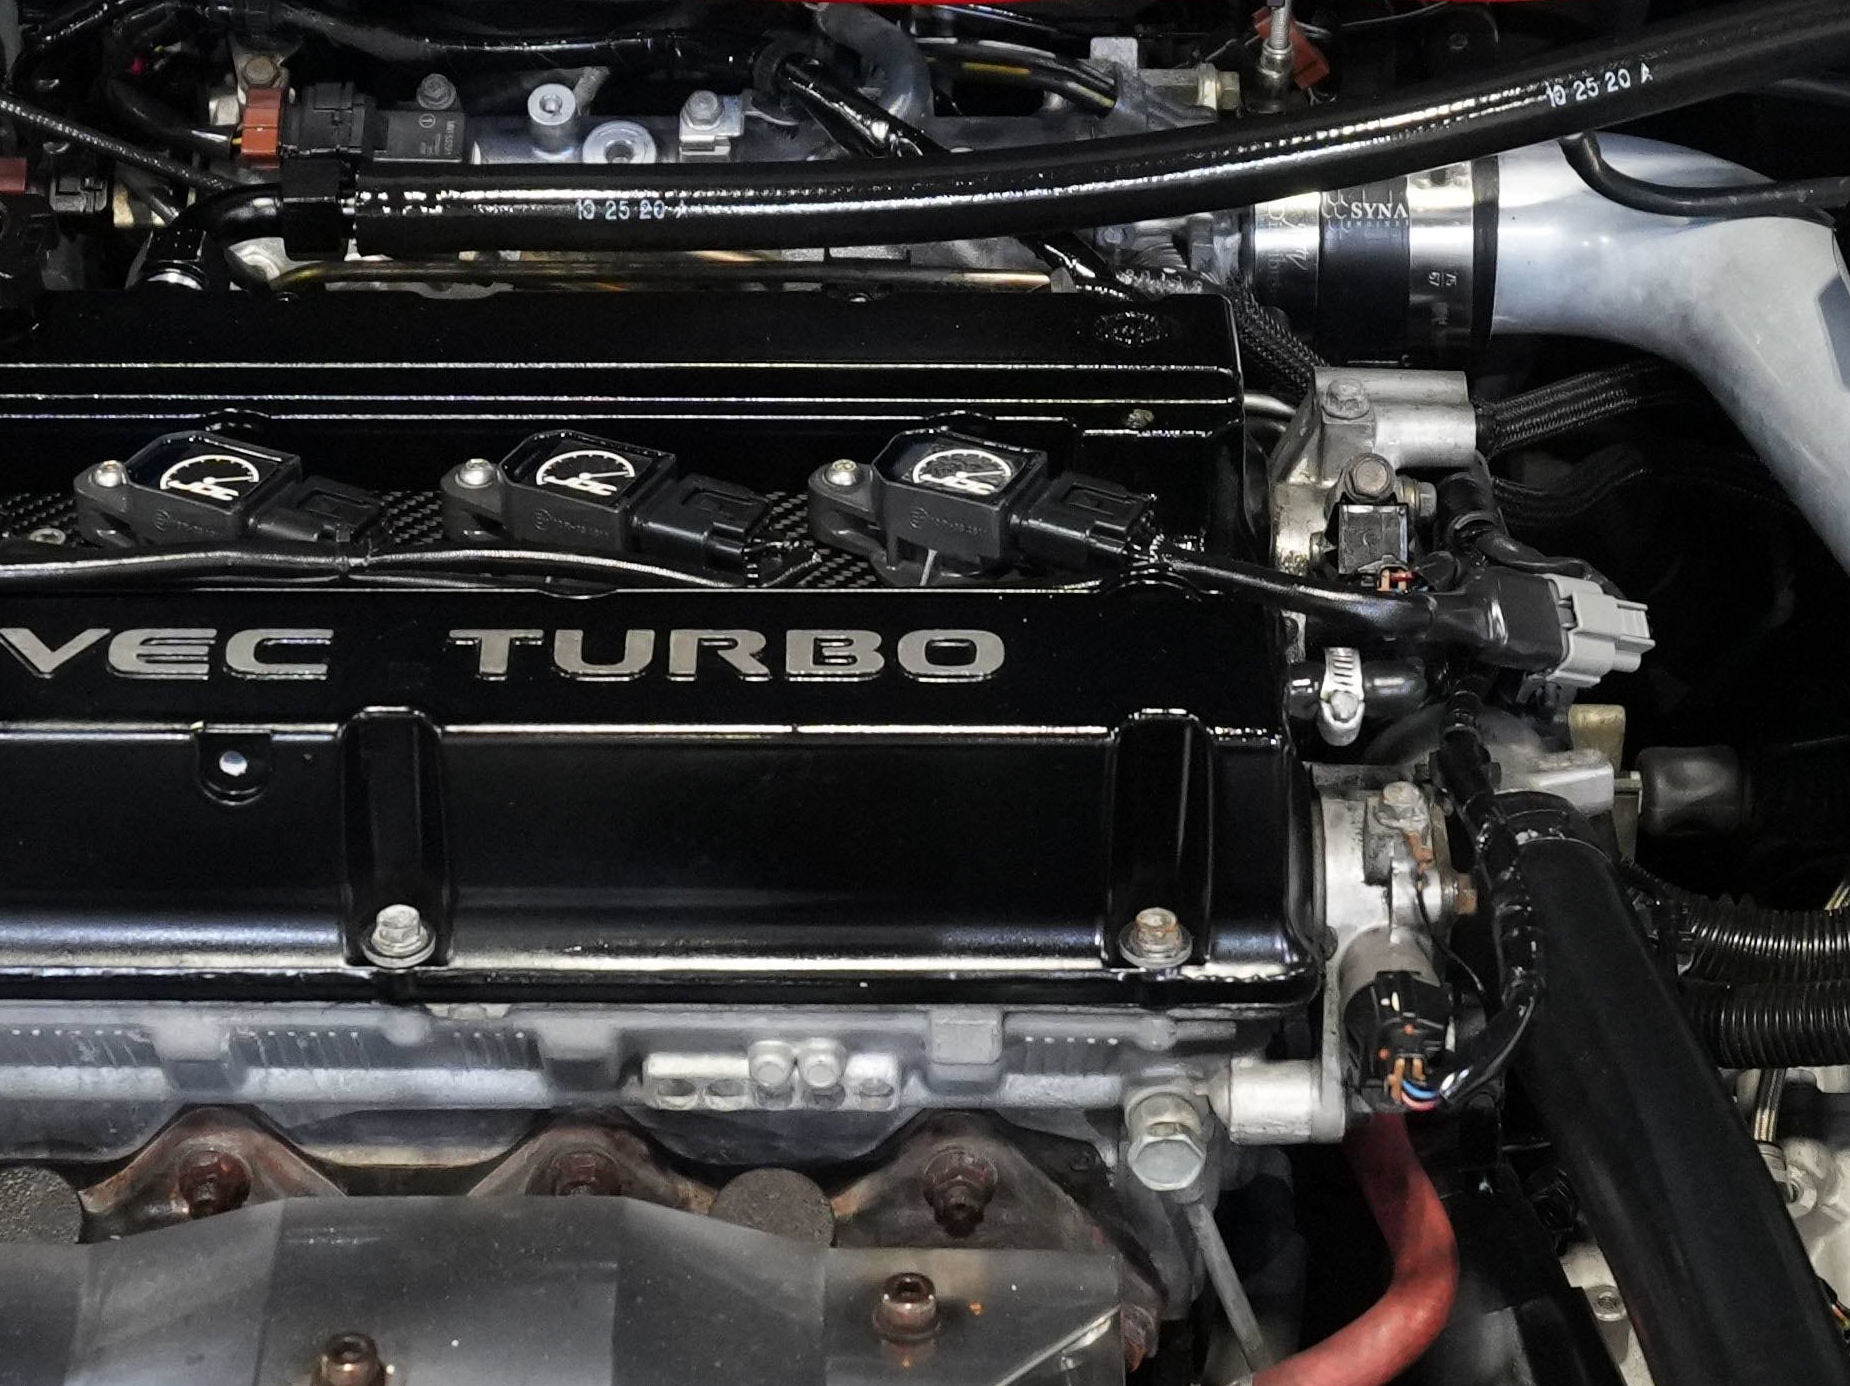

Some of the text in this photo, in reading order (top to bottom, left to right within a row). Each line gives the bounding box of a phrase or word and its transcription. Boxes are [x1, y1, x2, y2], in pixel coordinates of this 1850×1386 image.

[1573, 75, 1599, 100] 25
[1603, 68, 1632, 93] 20
[604, 199, 630, 220] 25
[638, 198, 665, 220] 20
[452, 626, 1006, 681] TURBO
